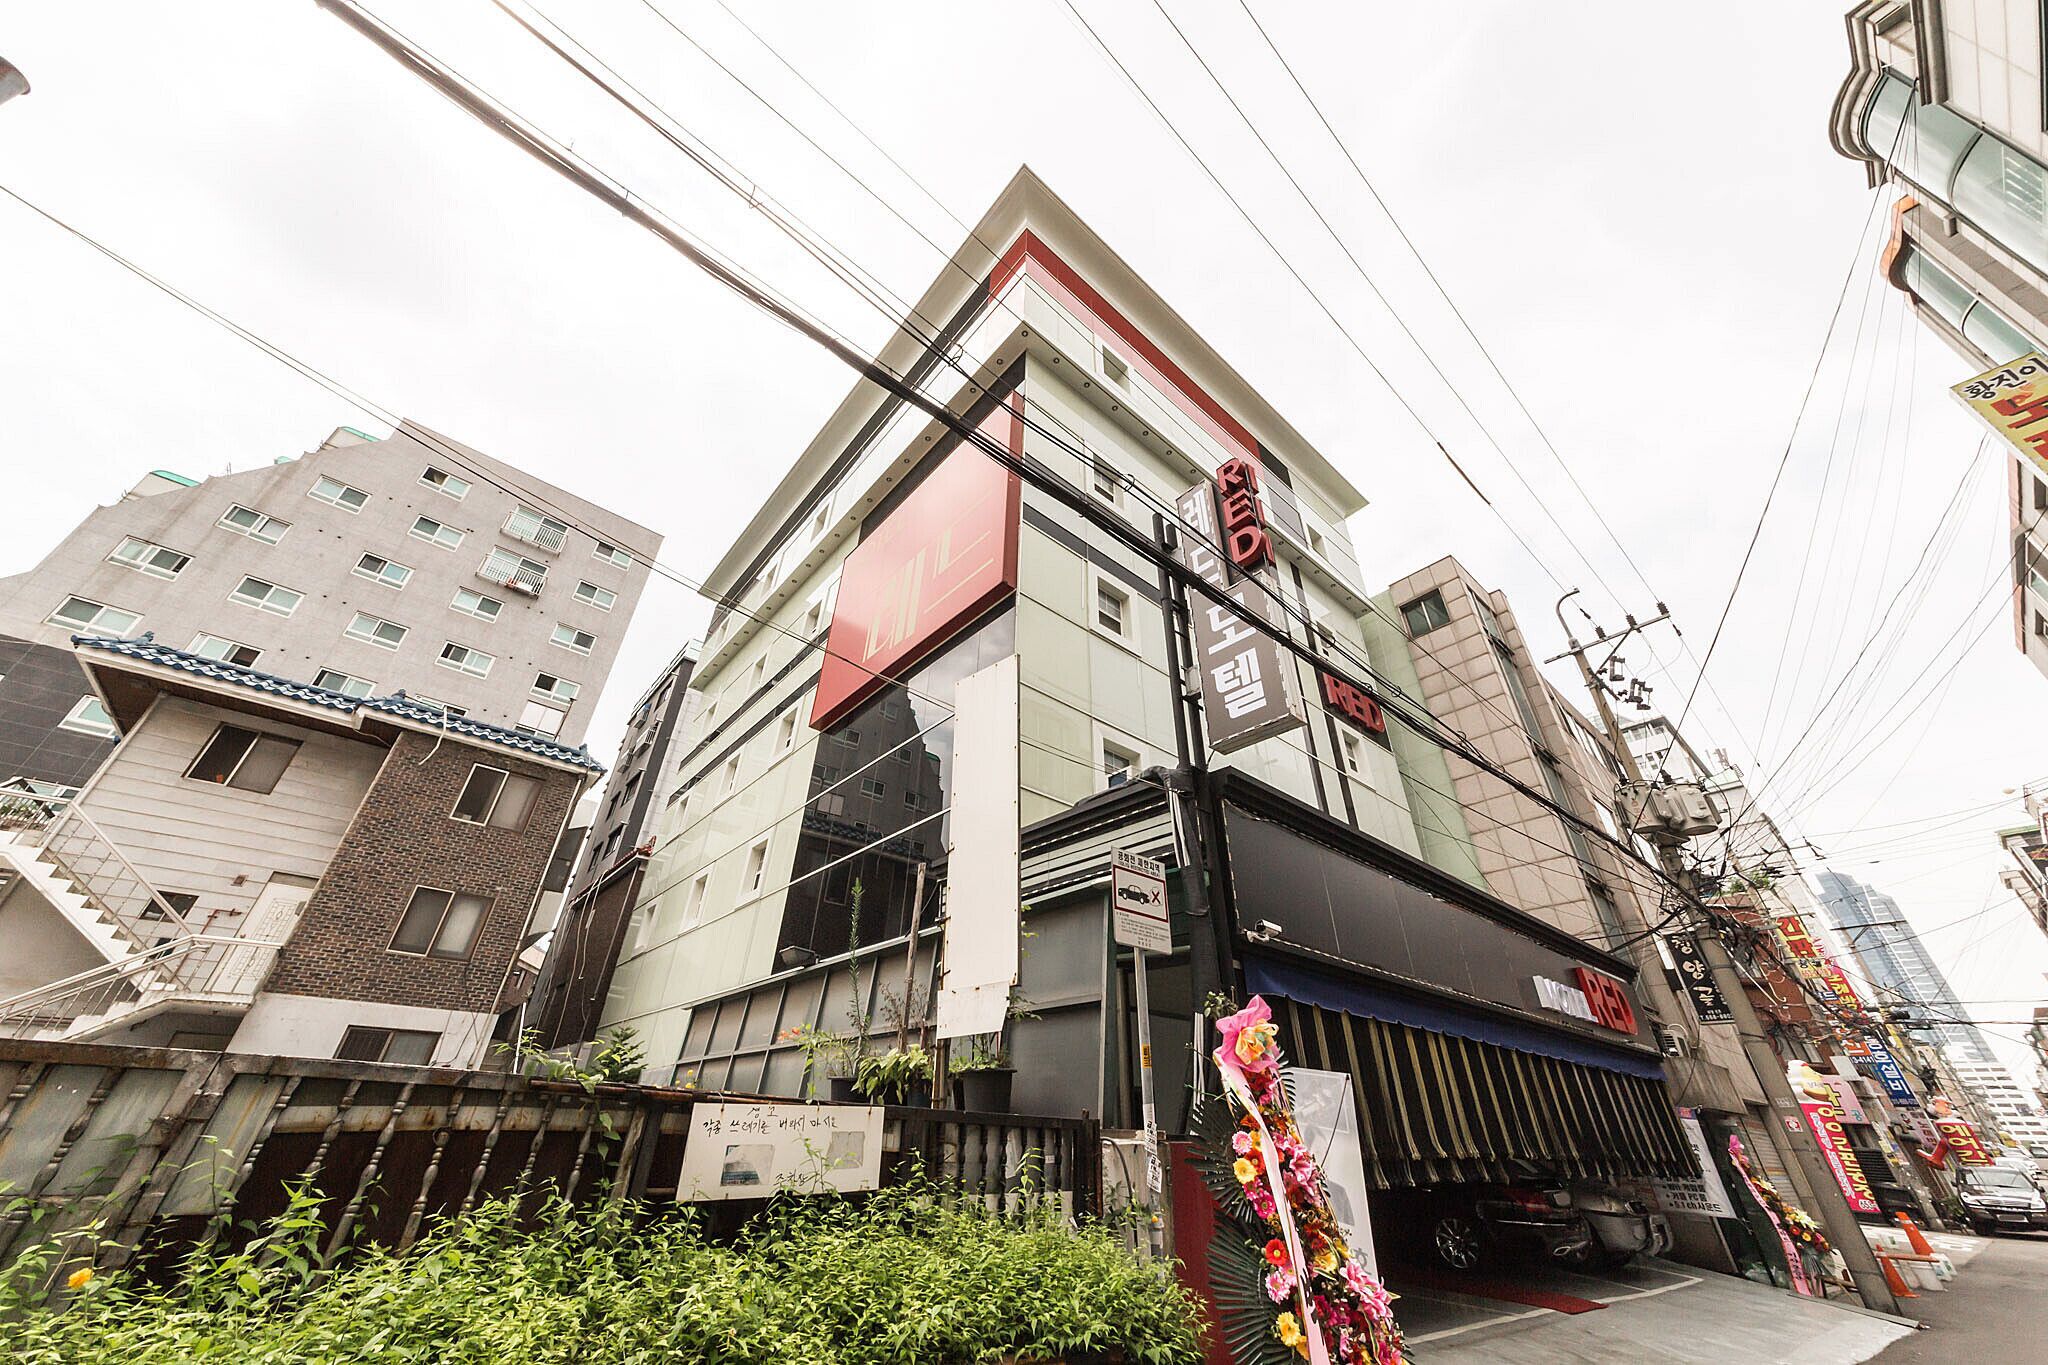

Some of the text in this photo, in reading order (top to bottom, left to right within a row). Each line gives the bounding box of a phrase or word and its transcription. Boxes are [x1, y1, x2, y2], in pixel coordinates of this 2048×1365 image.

[1964, 357, 2048, 399] 황진이
[1216, 458, 1274, 568] RED
[1322, 671, 1386, 734] RED
[1576, 966, 1638, 1035] RED
